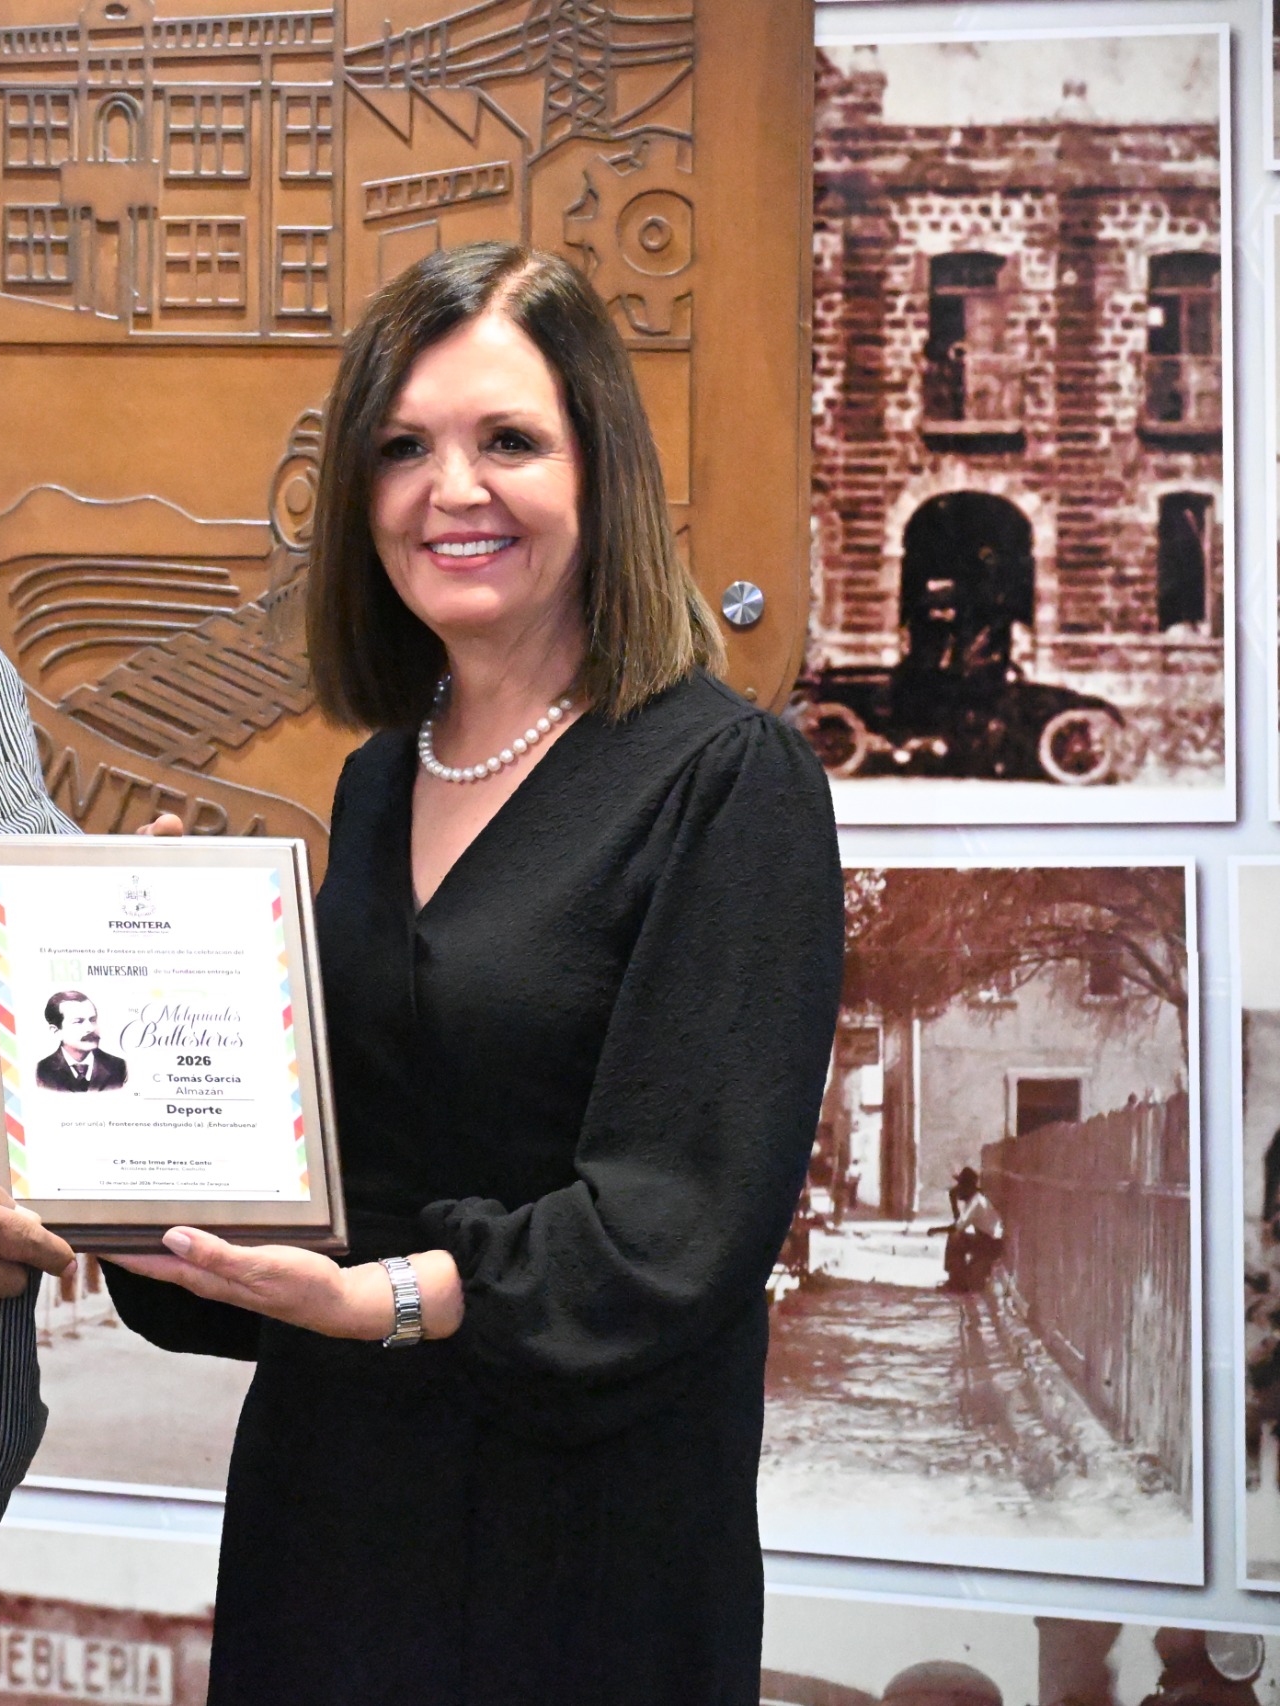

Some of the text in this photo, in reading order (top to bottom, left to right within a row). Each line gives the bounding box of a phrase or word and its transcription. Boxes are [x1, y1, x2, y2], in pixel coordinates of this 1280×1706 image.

[108, 920, 172, 929] FRONTERA
[47, 947, 96, 955] Ayuntamiento
[87, 965, 148, 976] ANIVERSARIO
[119, 1019, 243, 1053] Ballesteros
[176, 1055, 212, 1066] 2026
[166, 1073, 202, 1083] Tomás
[175, 1086, 224, 1096] Almazán
[166, 1104, 223, 1117] Deporte
[152, 1121, 193, 1129] distinguido
